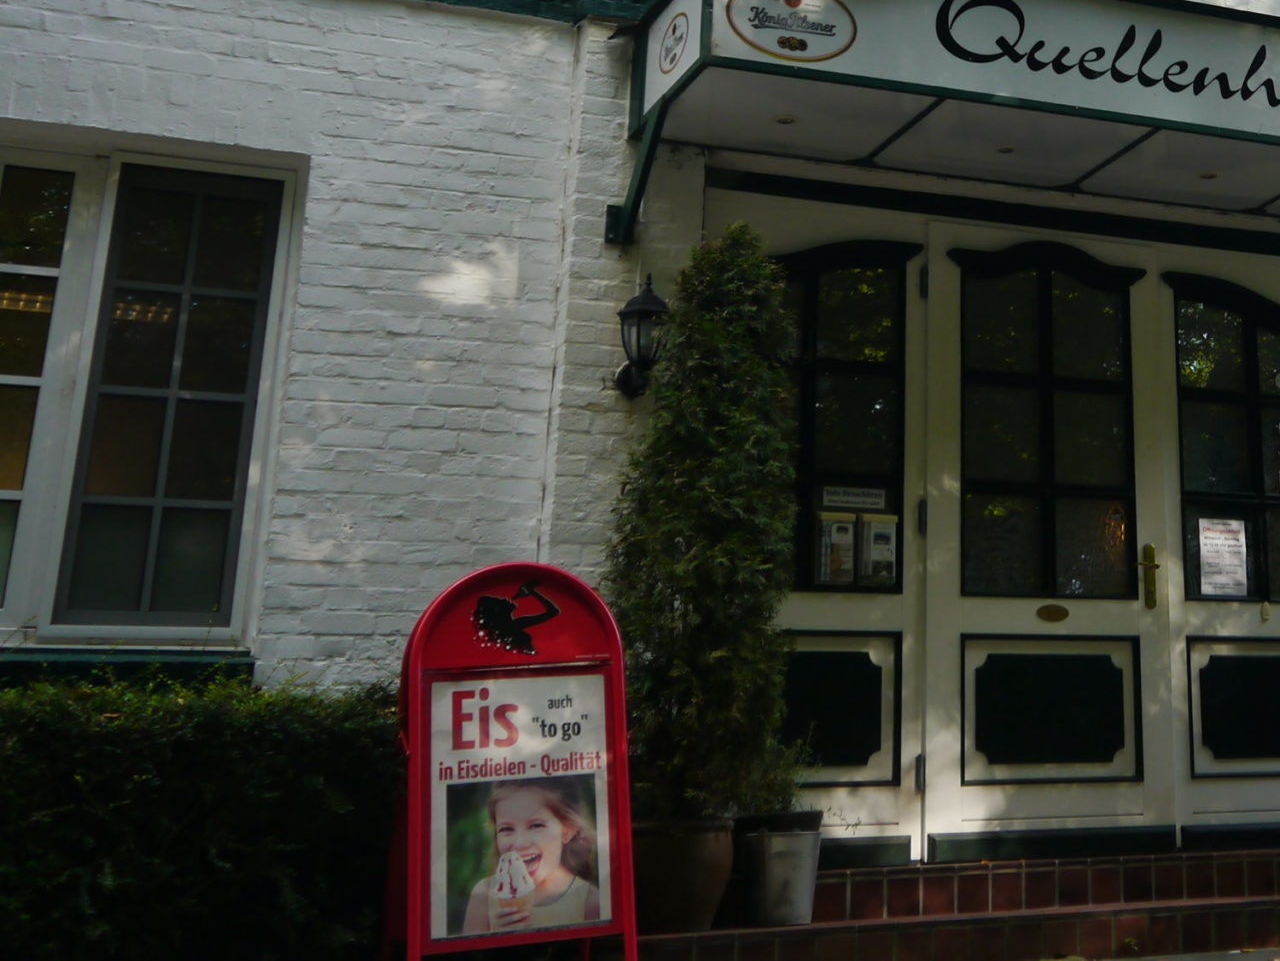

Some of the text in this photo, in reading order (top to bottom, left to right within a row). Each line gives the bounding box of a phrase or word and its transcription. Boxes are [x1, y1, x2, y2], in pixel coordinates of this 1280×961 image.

[748, 6, 789, 28] König
[547, 694, 572, 710] auch
[452, 687, 519, 750] Eis
[438, 761, 453, 781] in
[457, 756, 526, 780] Eisdielen
[540, 751, 602, 775] Qualität
